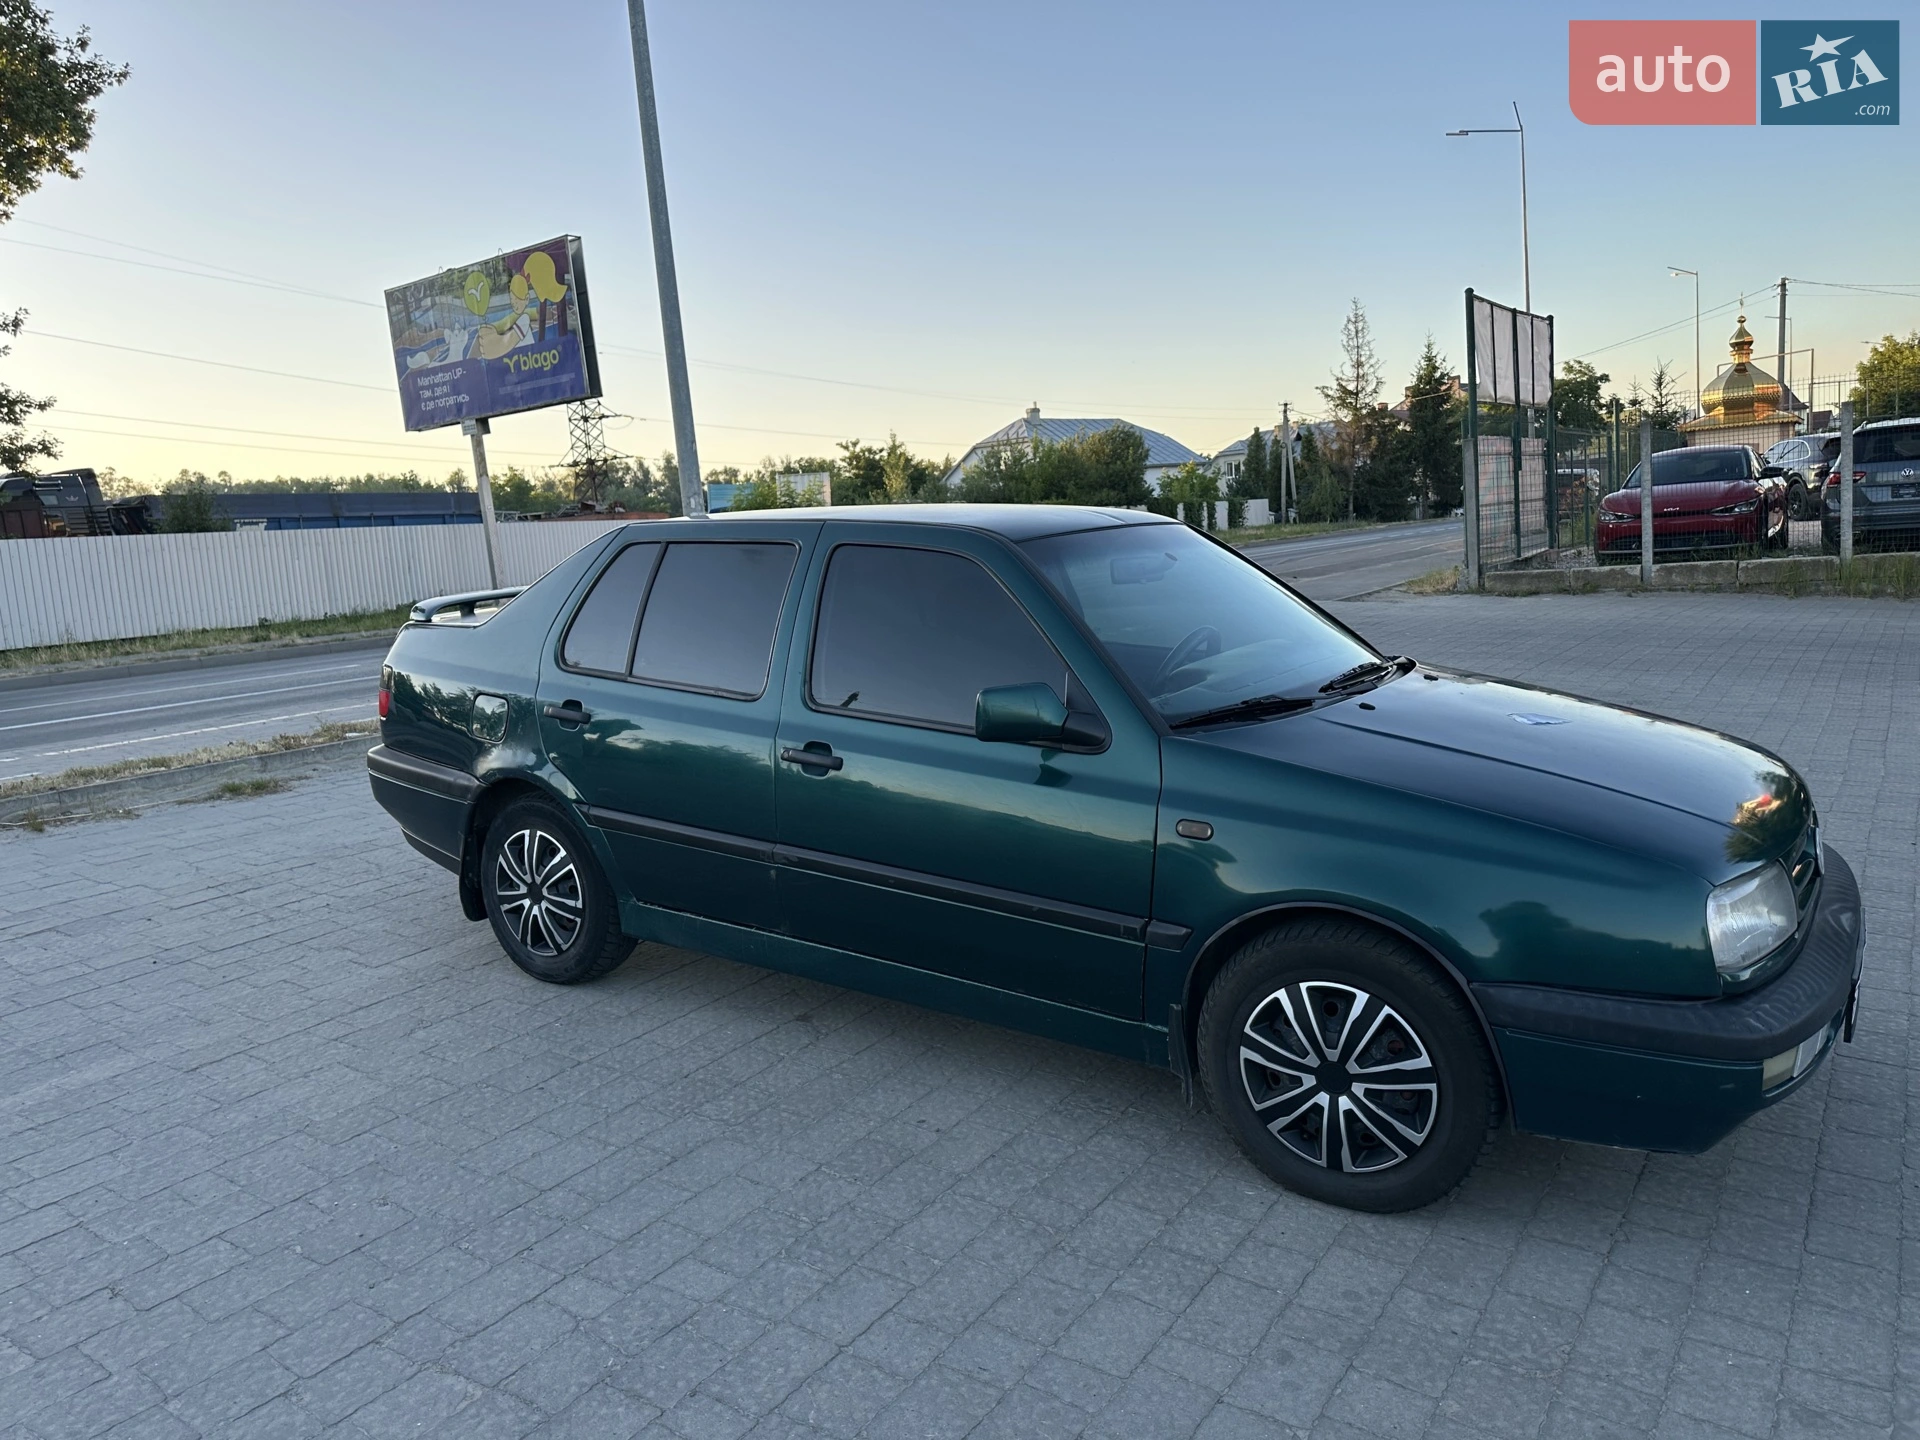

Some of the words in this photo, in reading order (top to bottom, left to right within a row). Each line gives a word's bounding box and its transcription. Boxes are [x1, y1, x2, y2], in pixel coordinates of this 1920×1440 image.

[417, 372, 453, 386] Manhattan
[452, 368, 462, 379] UP
[434, 387, 442, 397] де
[421, 402, 426, 411] є
[426, 400, 435, 411] де
[435, 394, 469, 408] погратись
